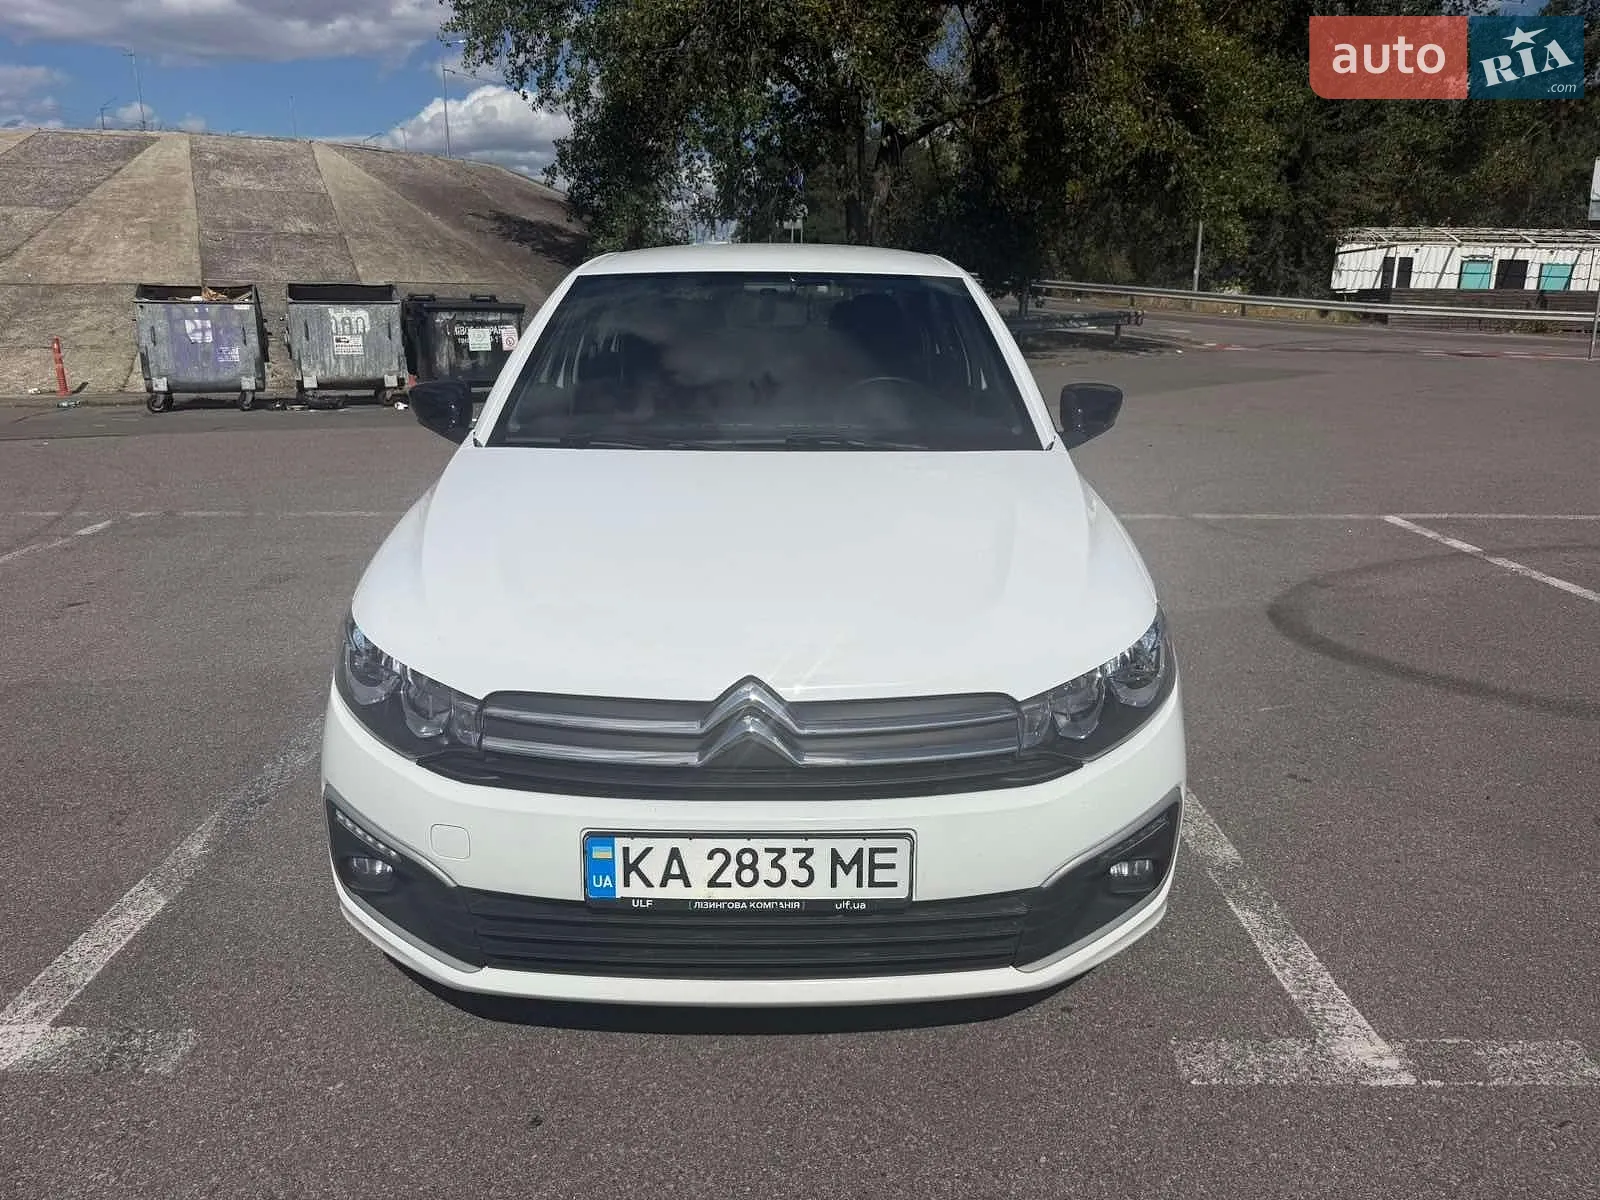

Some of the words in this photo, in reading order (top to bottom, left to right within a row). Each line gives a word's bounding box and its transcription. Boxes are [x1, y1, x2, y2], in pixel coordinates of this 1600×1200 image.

[622, 846, 692, 889] KA
[706, 847, 815, 889] 2833
[830, 847, 898, 889] ME
[592, 874, 613, 888] UA
[632, 898, 653, 908] ULF
[694, 901, 747, 909] ЛІЗИНГОВА
[835, 900, 866, 910] ulf.ua
